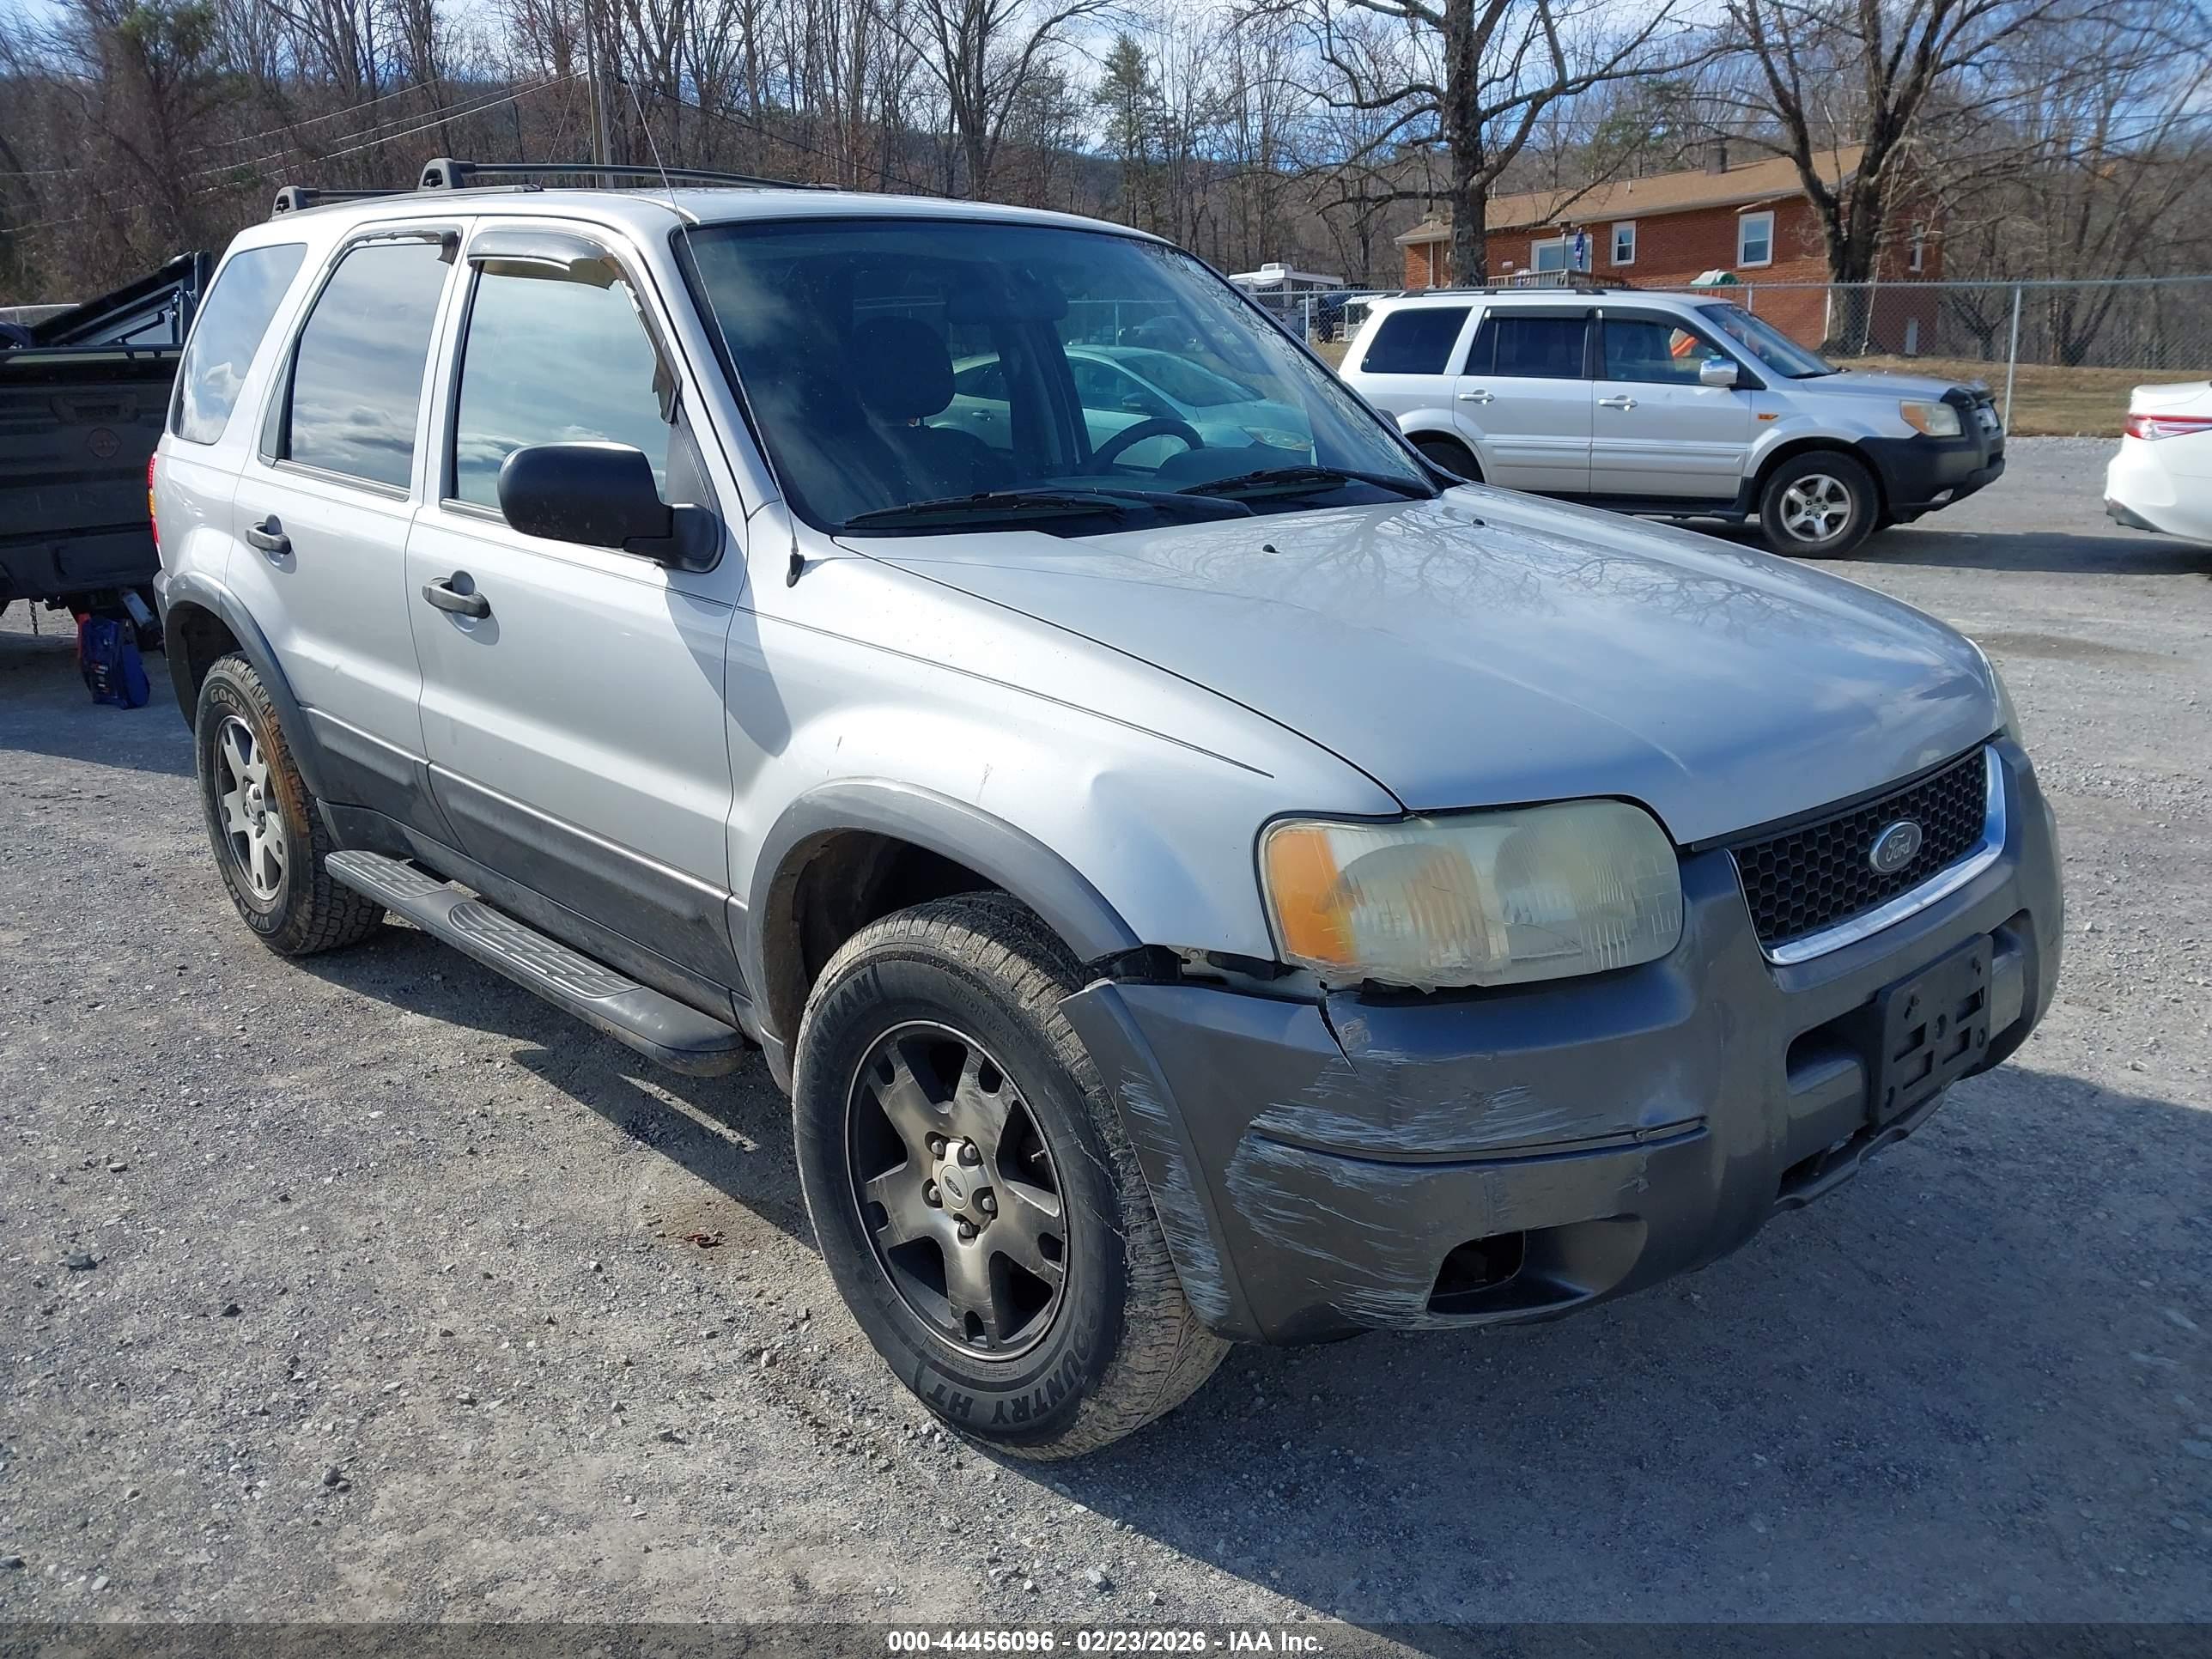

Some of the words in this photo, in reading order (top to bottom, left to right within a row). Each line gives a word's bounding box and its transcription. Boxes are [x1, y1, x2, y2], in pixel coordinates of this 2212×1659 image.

[1886, 833, 1911, 862] Ford
[989, 1290, 1099, 1425] COUNTRY
[926, 1382, 975, 1419] HT
